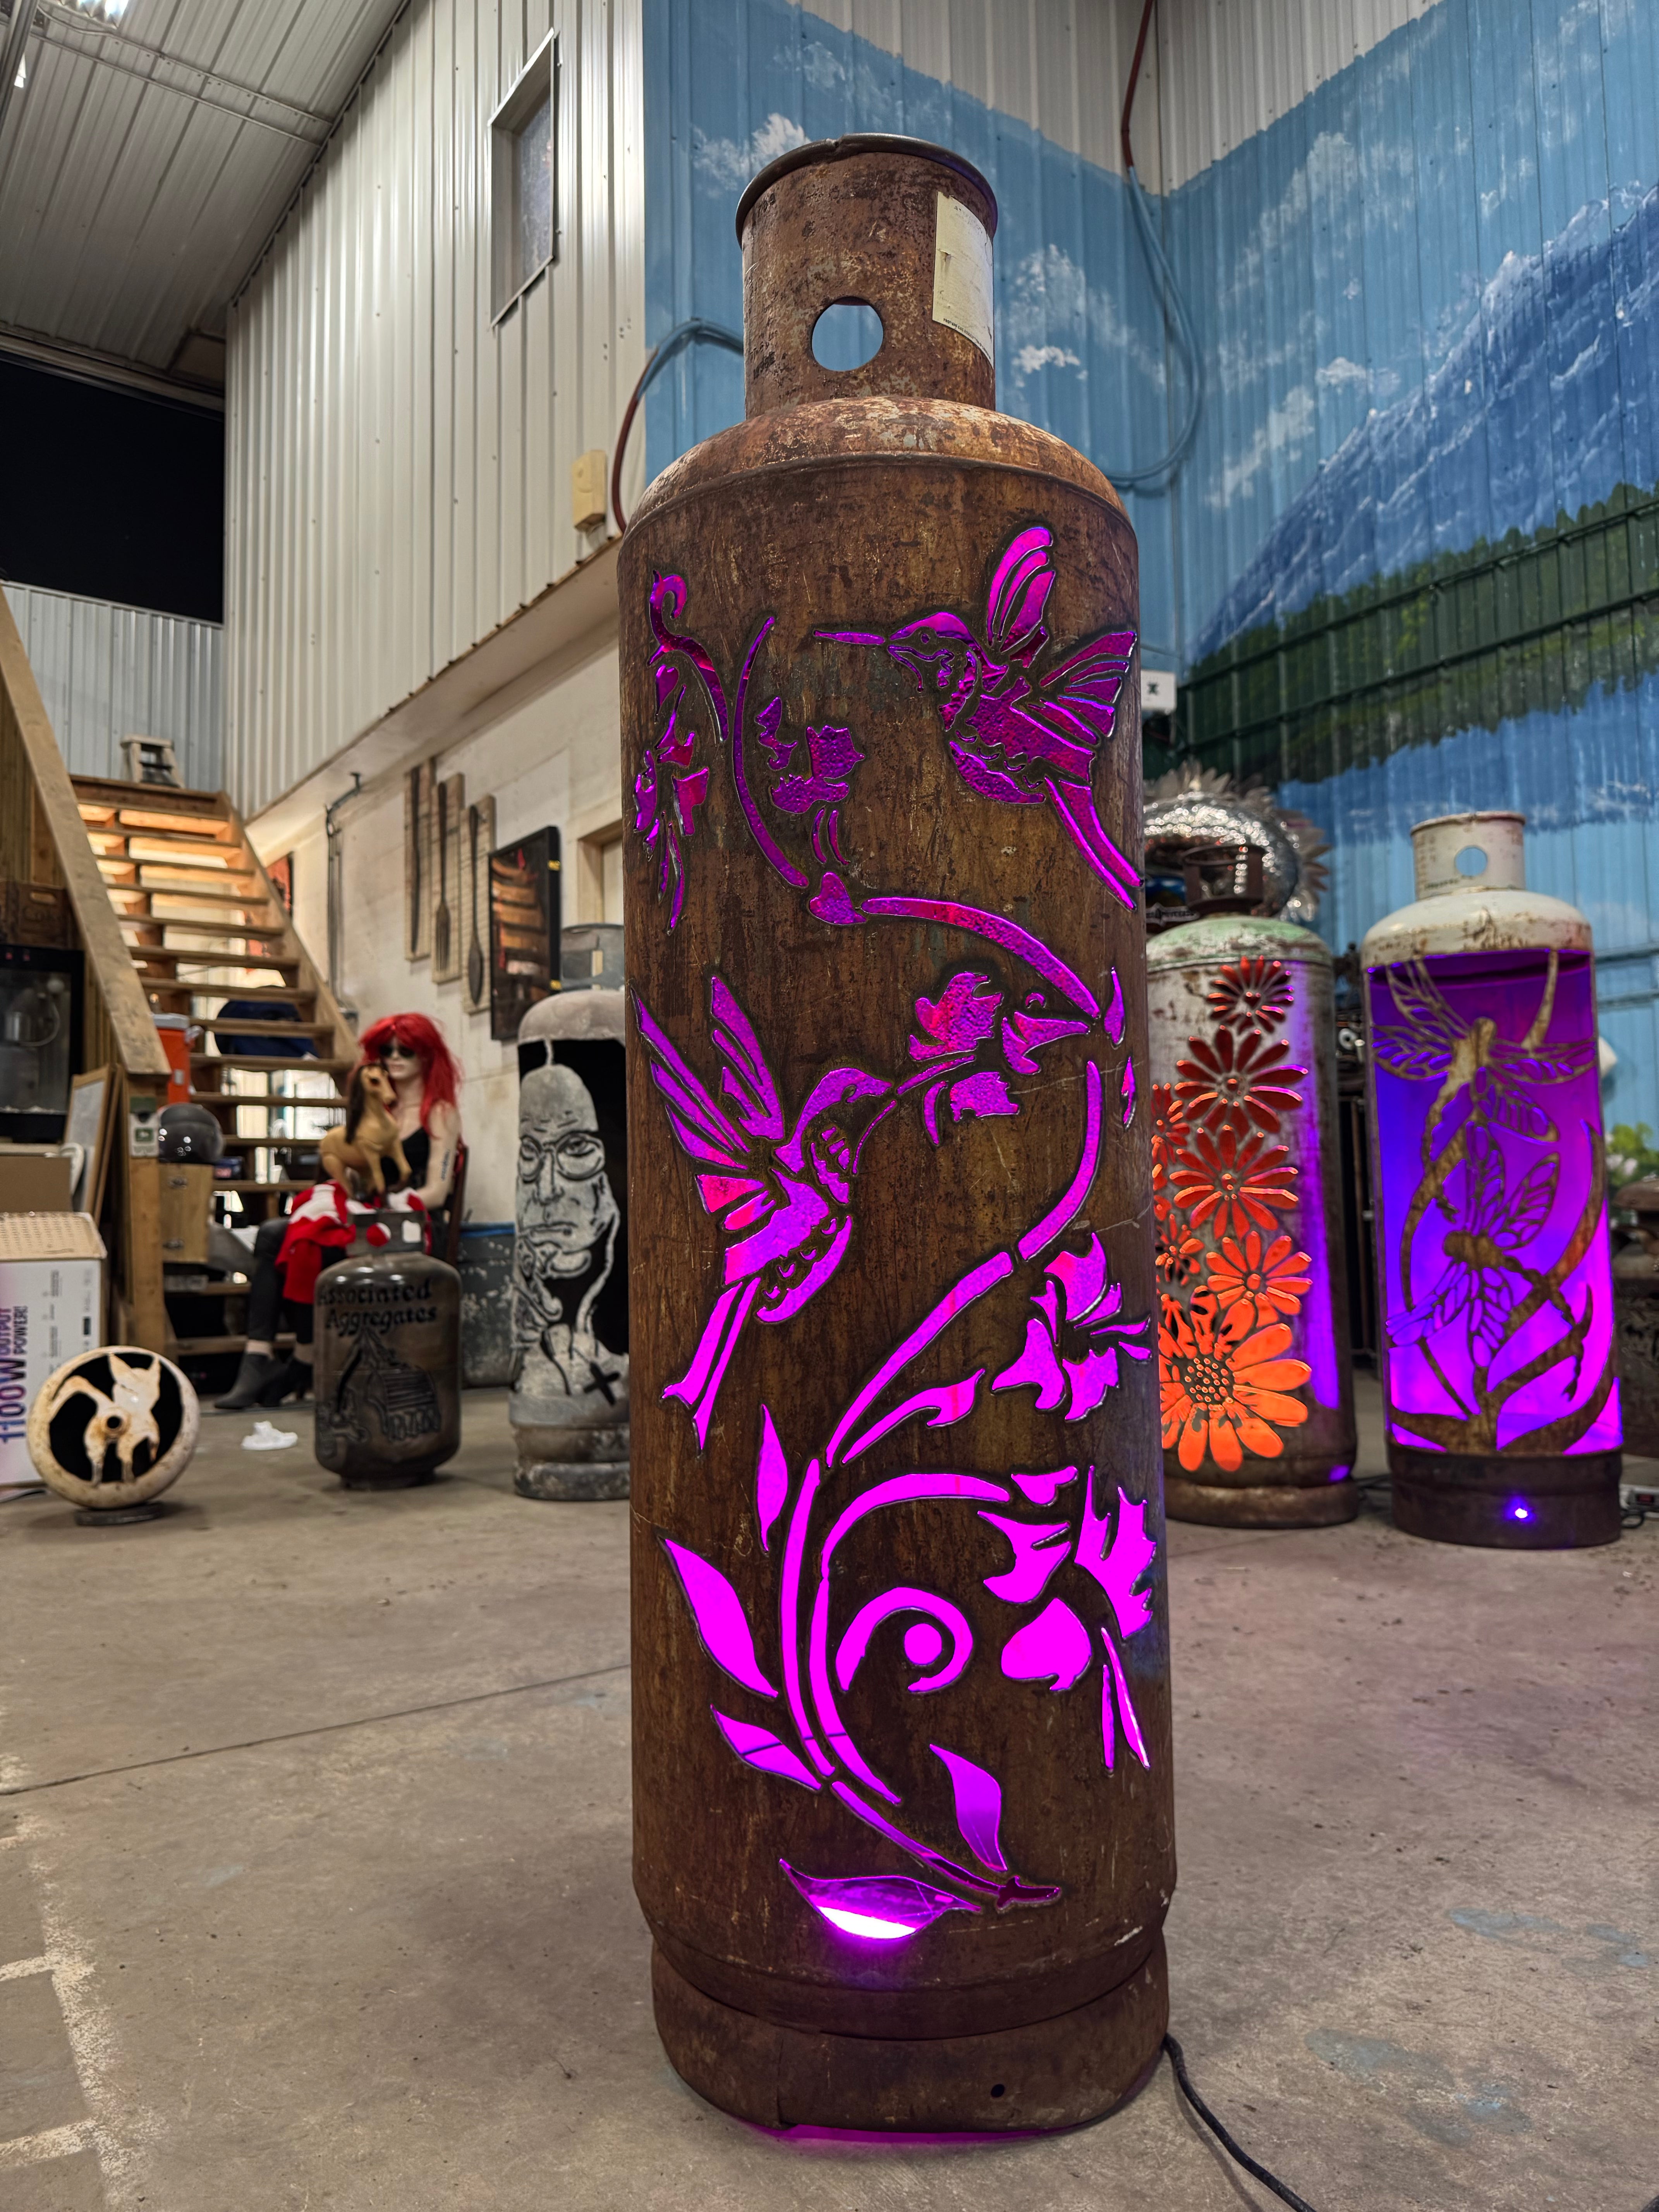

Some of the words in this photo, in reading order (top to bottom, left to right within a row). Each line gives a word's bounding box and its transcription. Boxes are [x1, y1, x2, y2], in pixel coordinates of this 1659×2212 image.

[318, 1278, 431, 1305] Associated
[325, 1307, 437, 1337] Aggregates
[0, 1357, 26, 1443] 1100W
